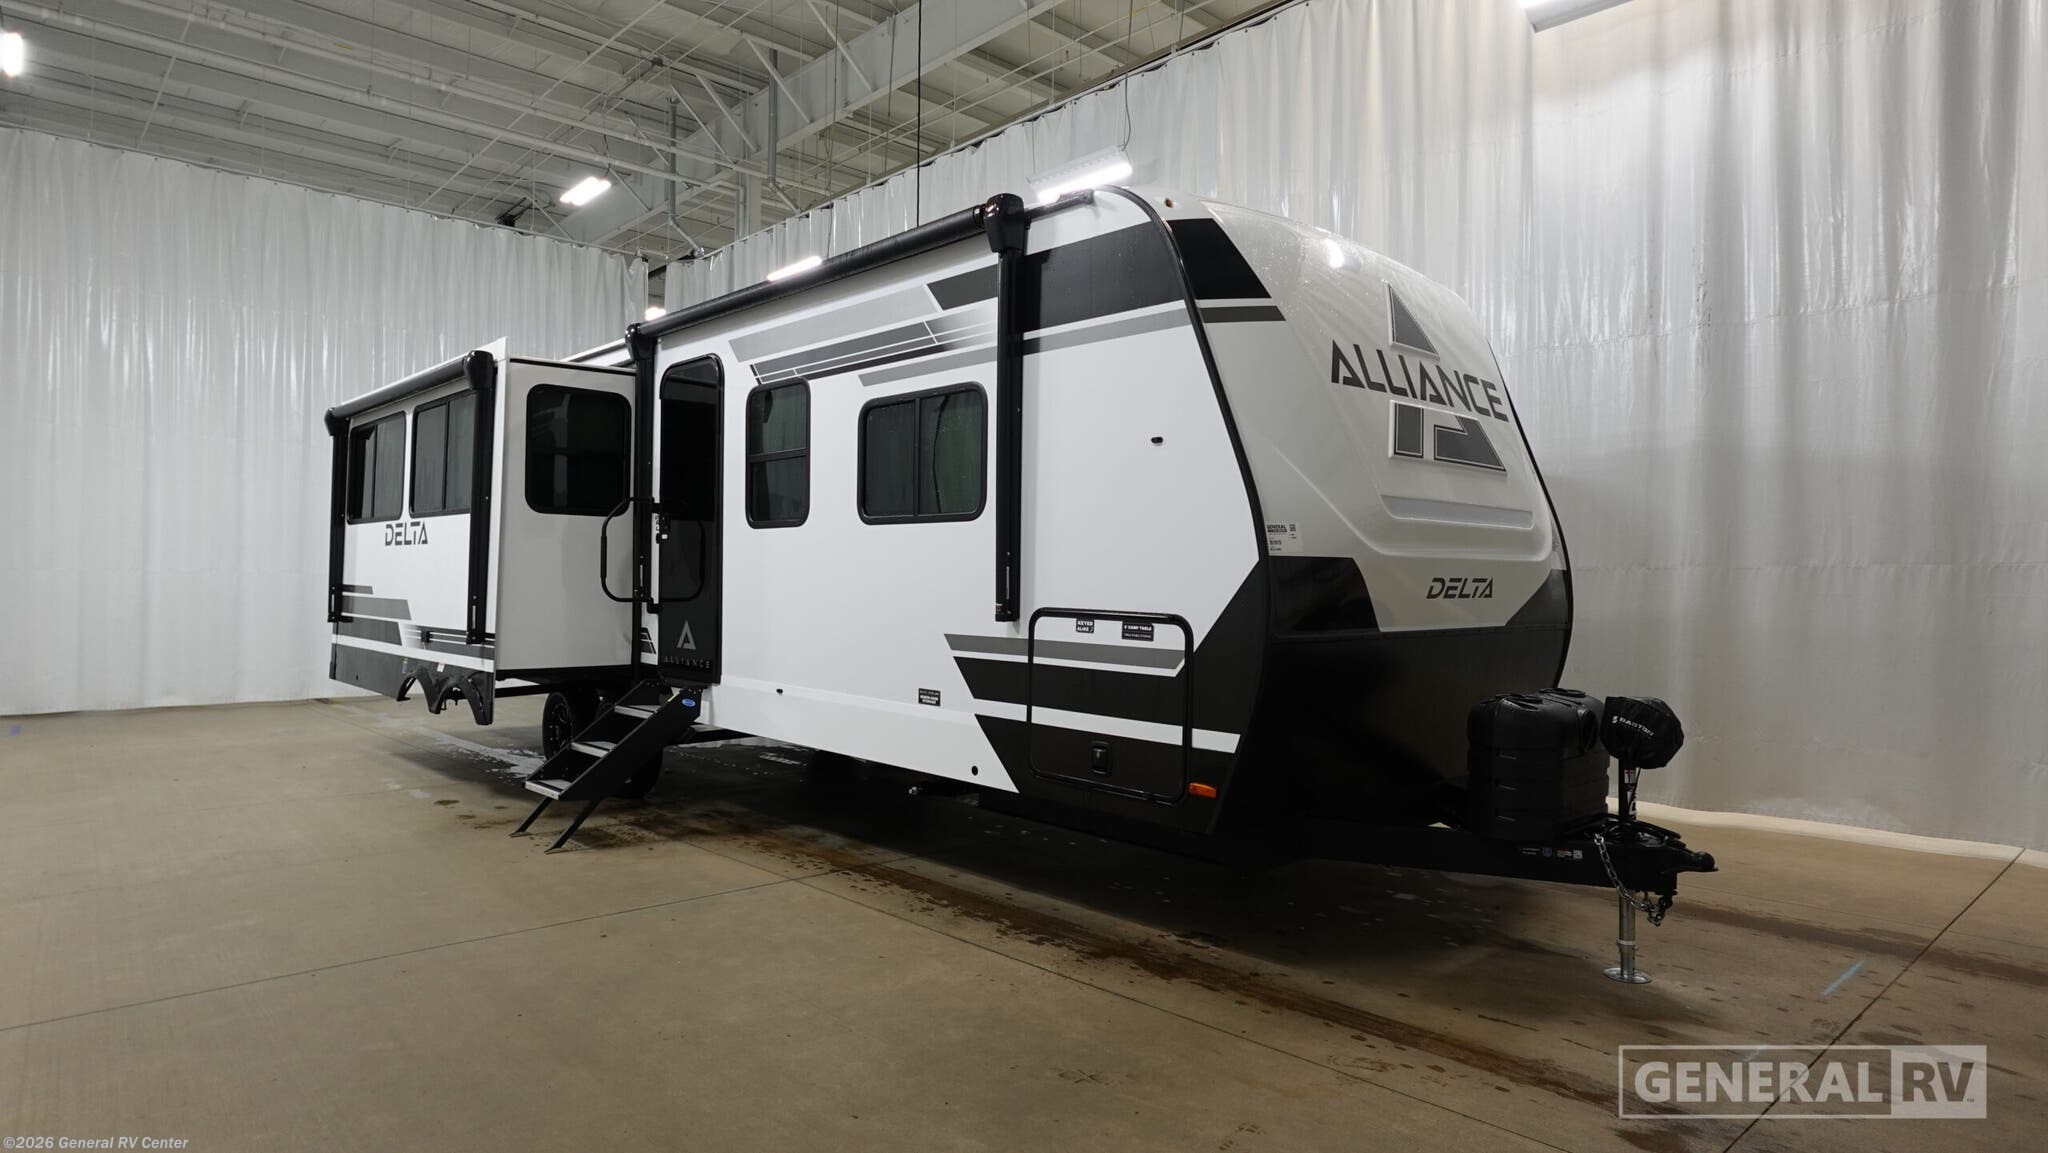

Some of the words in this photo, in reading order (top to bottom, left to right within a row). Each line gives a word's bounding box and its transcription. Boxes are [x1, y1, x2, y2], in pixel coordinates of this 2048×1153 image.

[1331, 339, 1509, 423] ALLIANCE
[385, 520, 428, 546] DELTA
[1426, 577, 1493, 599] DELTA
[663, 655, 711, 669] ALLIANCE
